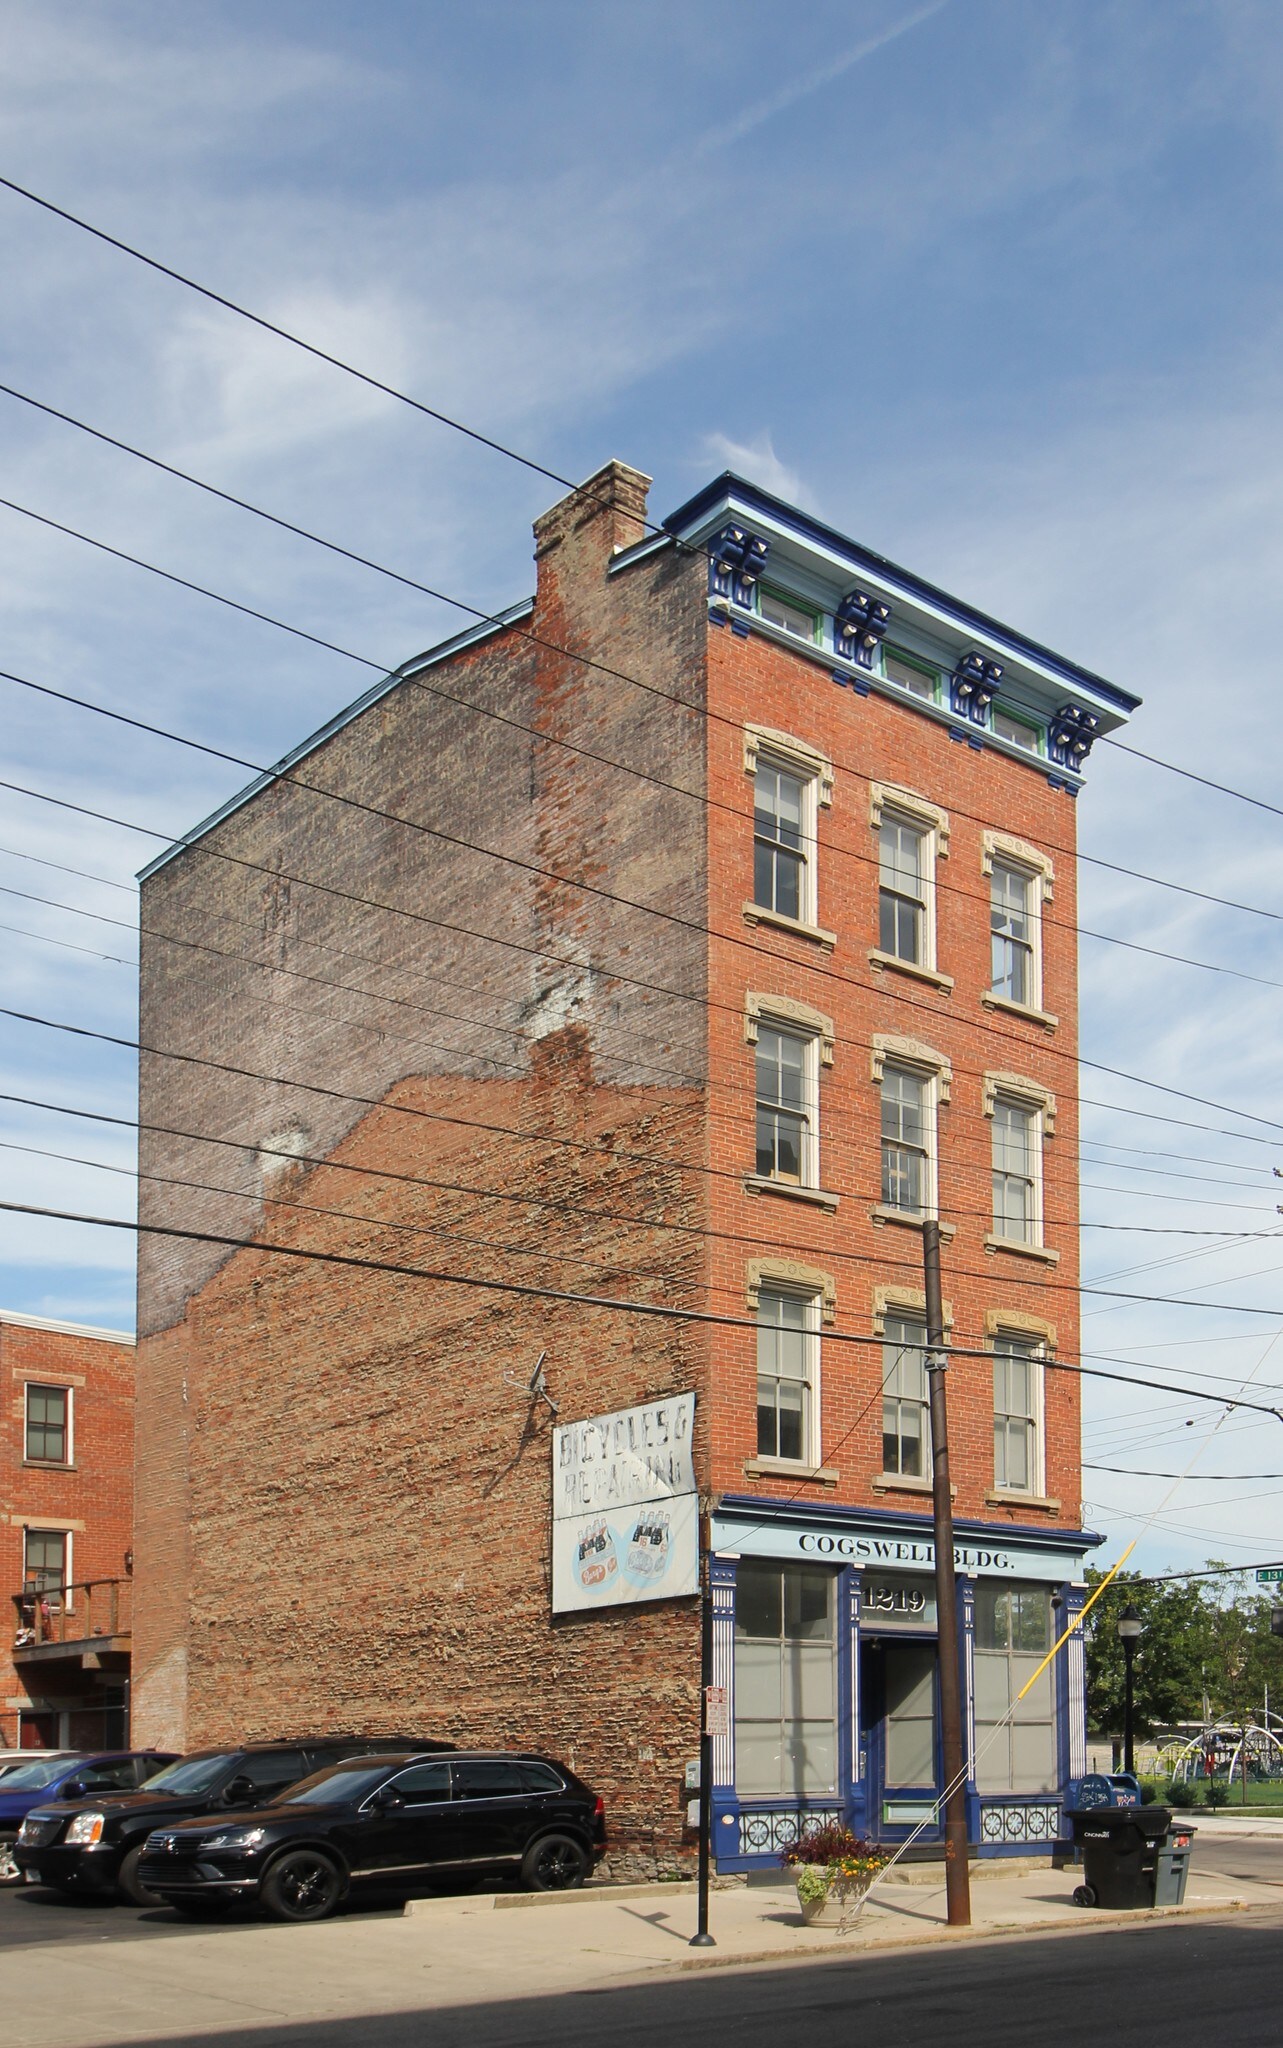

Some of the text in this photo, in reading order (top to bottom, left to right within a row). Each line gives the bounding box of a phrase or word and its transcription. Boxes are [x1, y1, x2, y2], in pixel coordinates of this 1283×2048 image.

[560, 1408, 670, 1469] BICYCLES
[798, 1534, 936, 1562] COGSWELL
[1257, 1571, 1265, 1581] E
[861, 1586, 926, 1612] 1219
